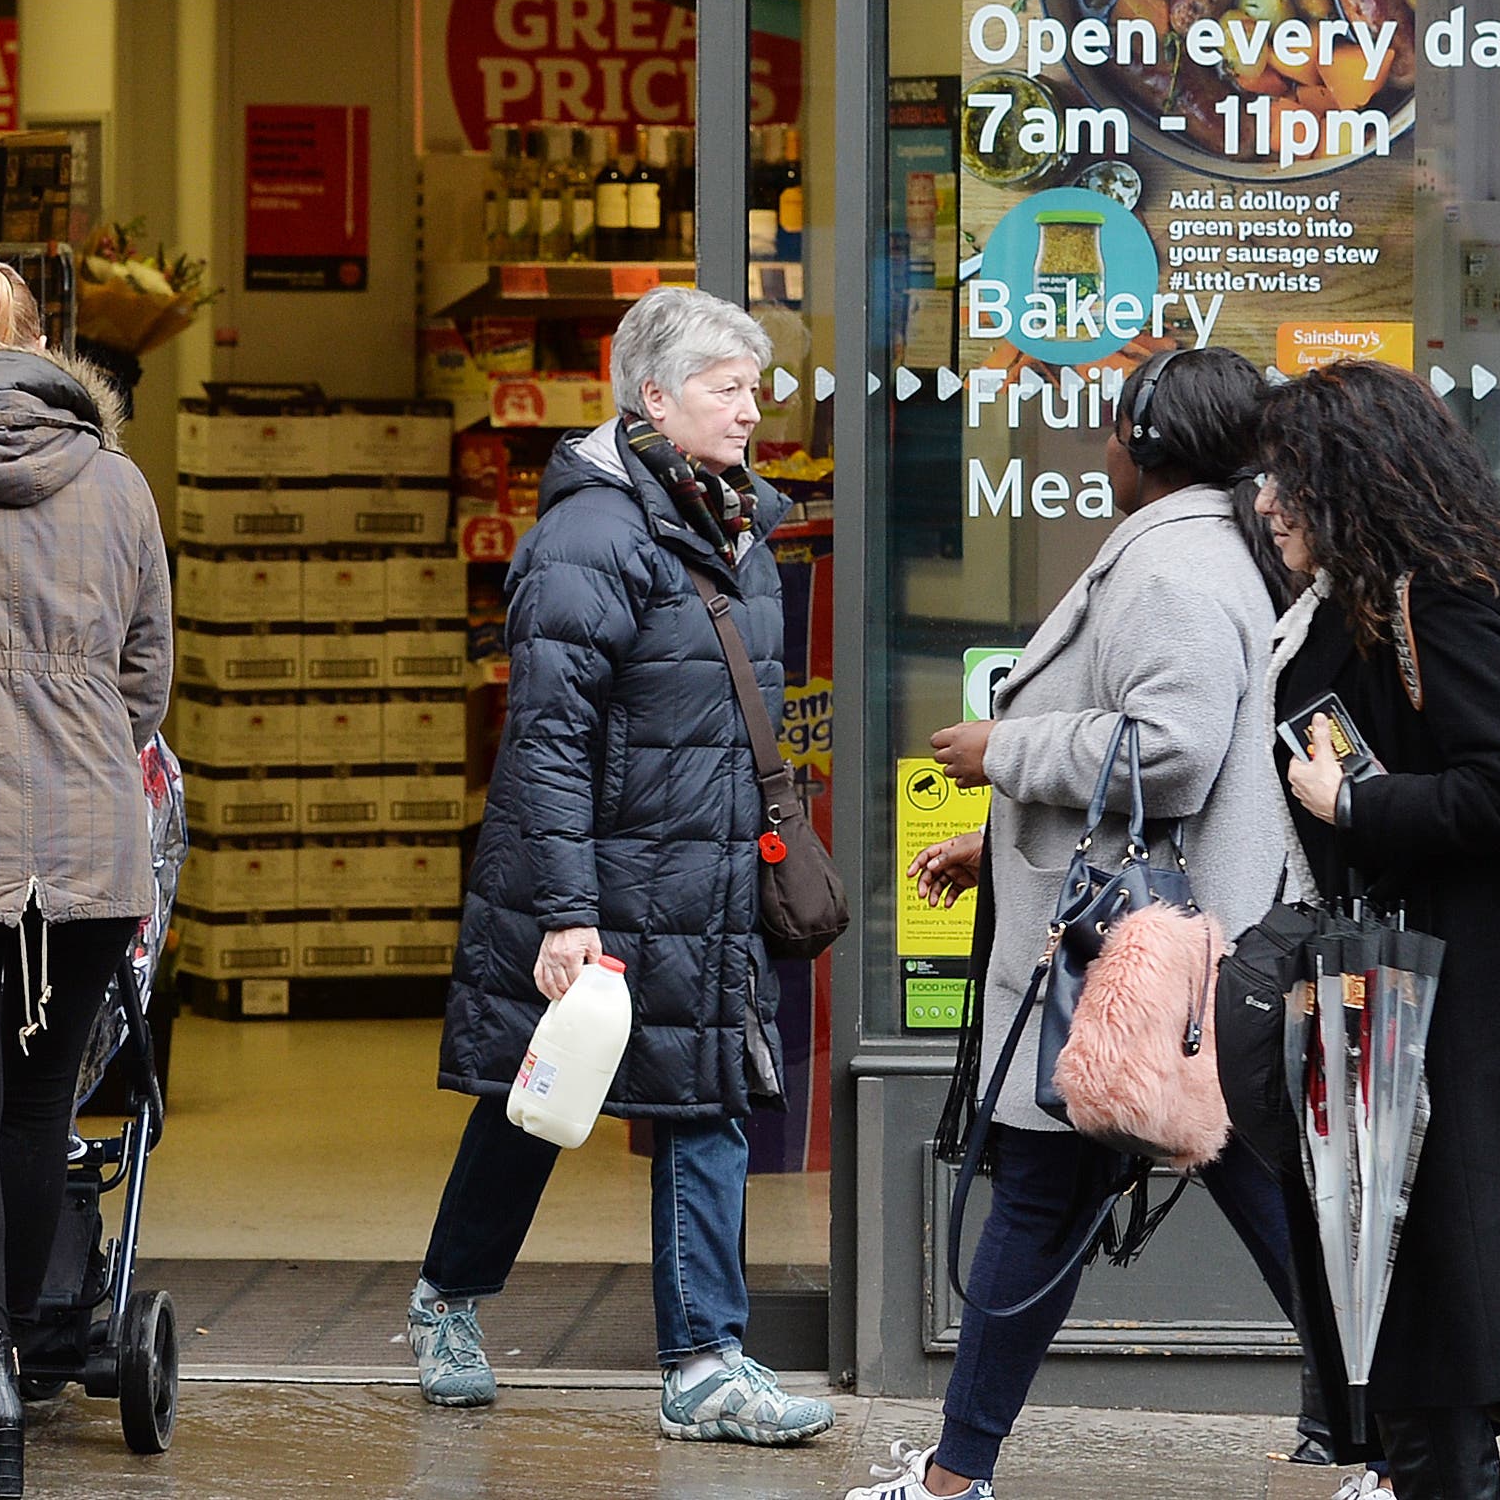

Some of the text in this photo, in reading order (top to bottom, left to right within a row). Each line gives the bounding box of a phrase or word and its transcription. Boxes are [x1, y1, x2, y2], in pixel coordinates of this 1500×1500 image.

[968, 3, 1157, 80] Open
[1186, 18, 1399, 81] every
[477, 56, 778, 123] PRICS
[966, 94, 1129, 156] 7am
[1213, 95, 1391, 169] 11pm
[1169, 189, 1341, 215] Add a dollop of
[1168, 216, 1354, 242] green pesto into
[1168, 244, 1380, 269] your sausage stew
[1168, 270, 1322, 292] #LittleTwists
[967, 277, 1225, 351] Bakery
[1292, 329, 1382, 349] Sainsbury's
[967, 457, 1113, 519] Mea
